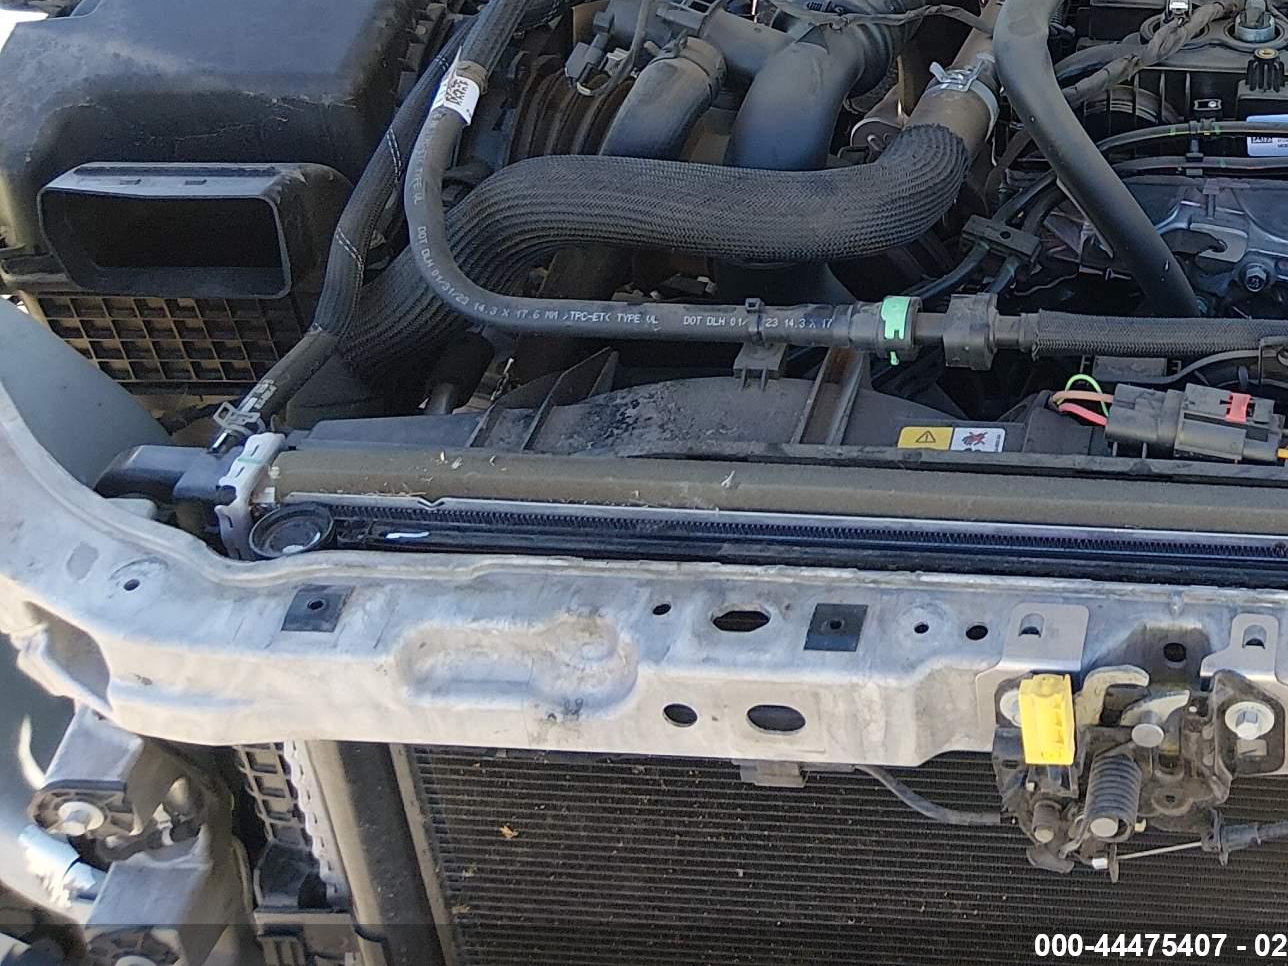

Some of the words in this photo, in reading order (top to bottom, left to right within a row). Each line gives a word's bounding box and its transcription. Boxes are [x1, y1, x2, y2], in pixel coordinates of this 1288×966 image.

[417, 225, 428, 244] DOT
[421, 248, 435, 268] DLH
[473, 302, 498, 316] 14.3
[501, 307, 510, 318] X
[516, 309, 541, 320] 17.6
[617, 313, 641, 323] TYPE
[683, 316, 702, 326] DOT
[707, 317, 725, 327] DLH
[784, 319, 806, 329] 14.3
